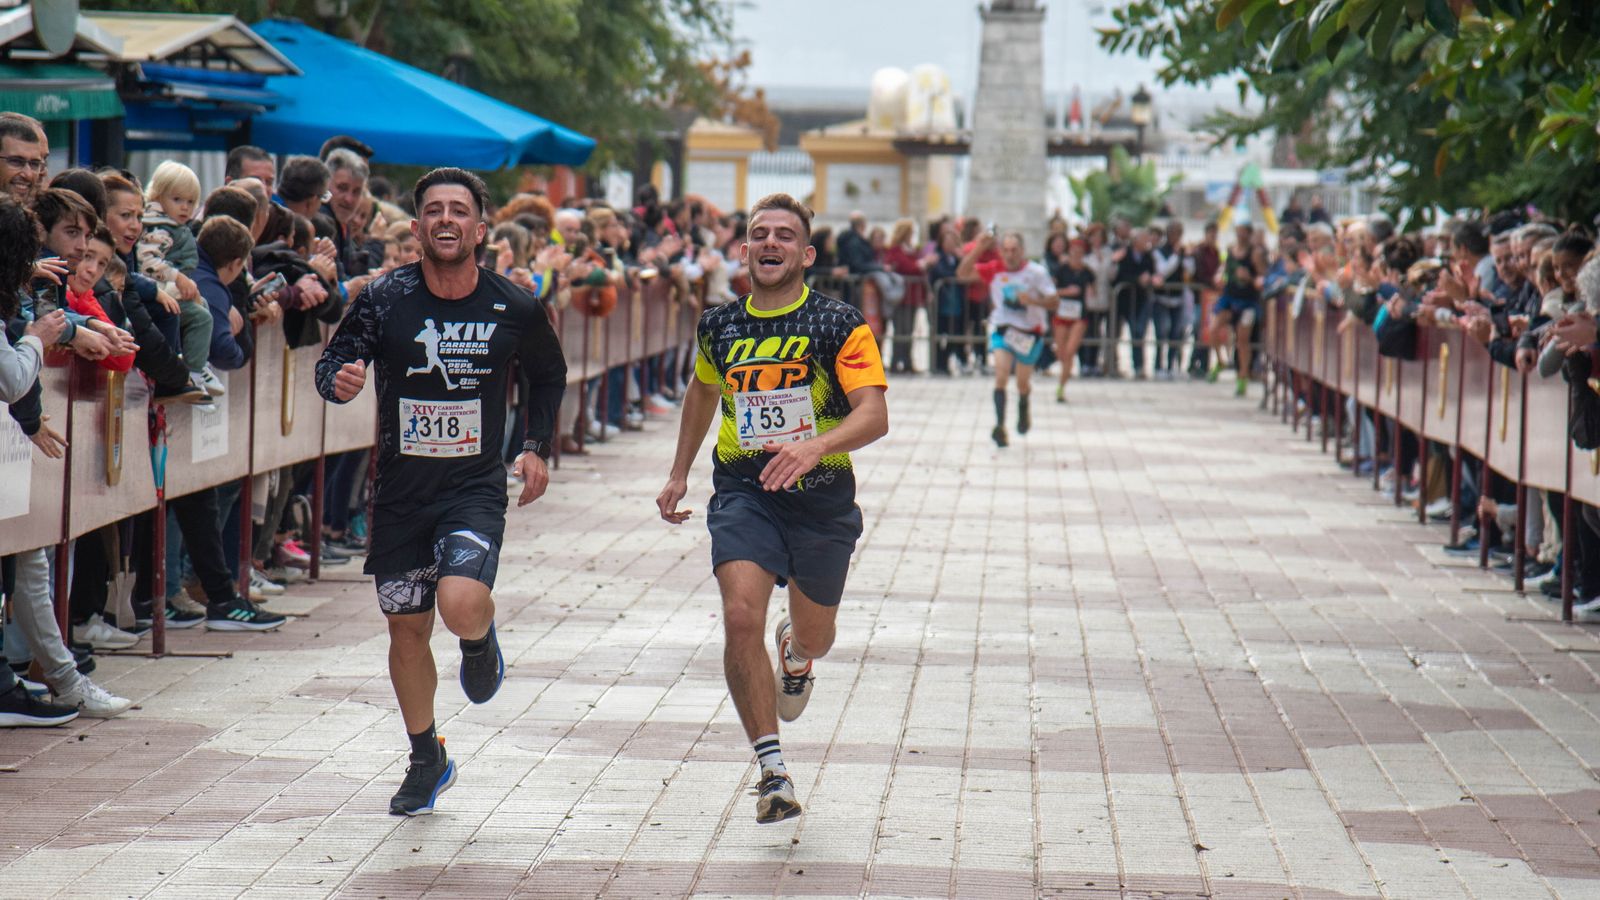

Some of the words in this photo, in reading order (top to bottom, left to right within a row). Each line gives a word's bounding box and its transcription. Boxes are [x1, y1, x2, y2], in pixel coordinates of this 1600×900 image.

[442, 322, 497, 341] XIV
[725, 363, 809, 395] STOP
[412, 404, 438, 416] XIV
[746, 395, 768, 407] XIV
[419, 416, 460, 438] 318
[760, 406, 786, 430] 53
